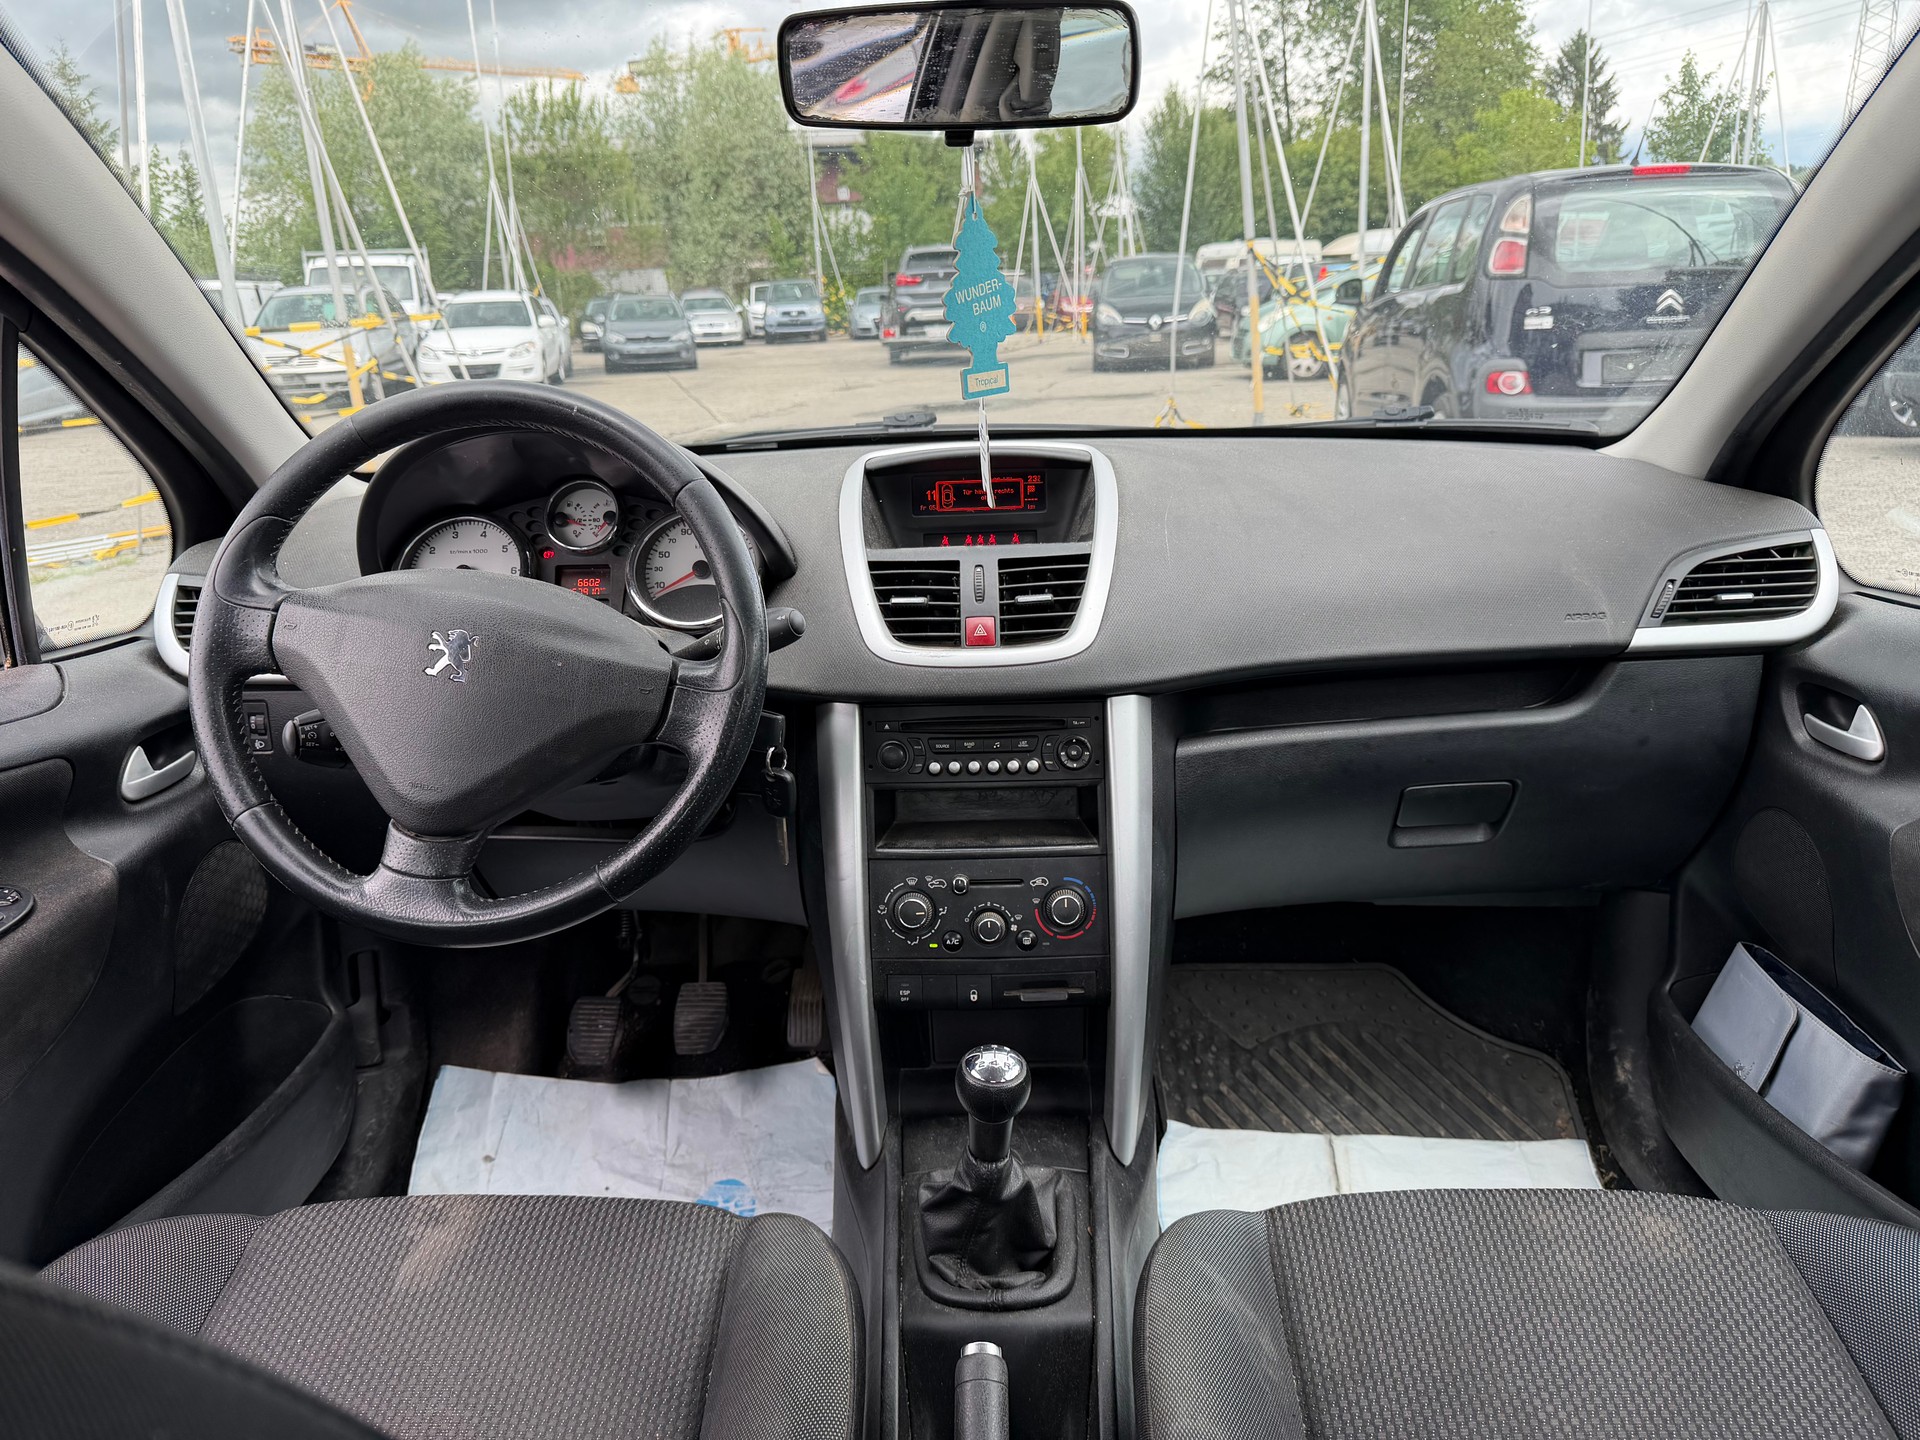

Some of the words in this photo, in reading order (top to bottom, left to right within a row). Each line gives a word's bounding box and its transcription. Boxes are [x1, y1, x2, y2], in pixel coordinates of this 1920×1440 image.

[955, 278, 1003, 304] WUNDER-
[972, 295, 1002, 316] BAUM
[974, 373, 999, 388] Tropical
[452, 531, 459, 539] 3
[479, 530, 487, 538] 4
[680, 528, 693, 536] 90
[429, 546, 436, 555] 2
[501, 544, 509, 553] 5
[658, 550, 671, 559] 50
[510, 566, 518, 575] 6
[654, 581, 666, 589] 10
[1564, 611, 1607, 621] AIRBAG
